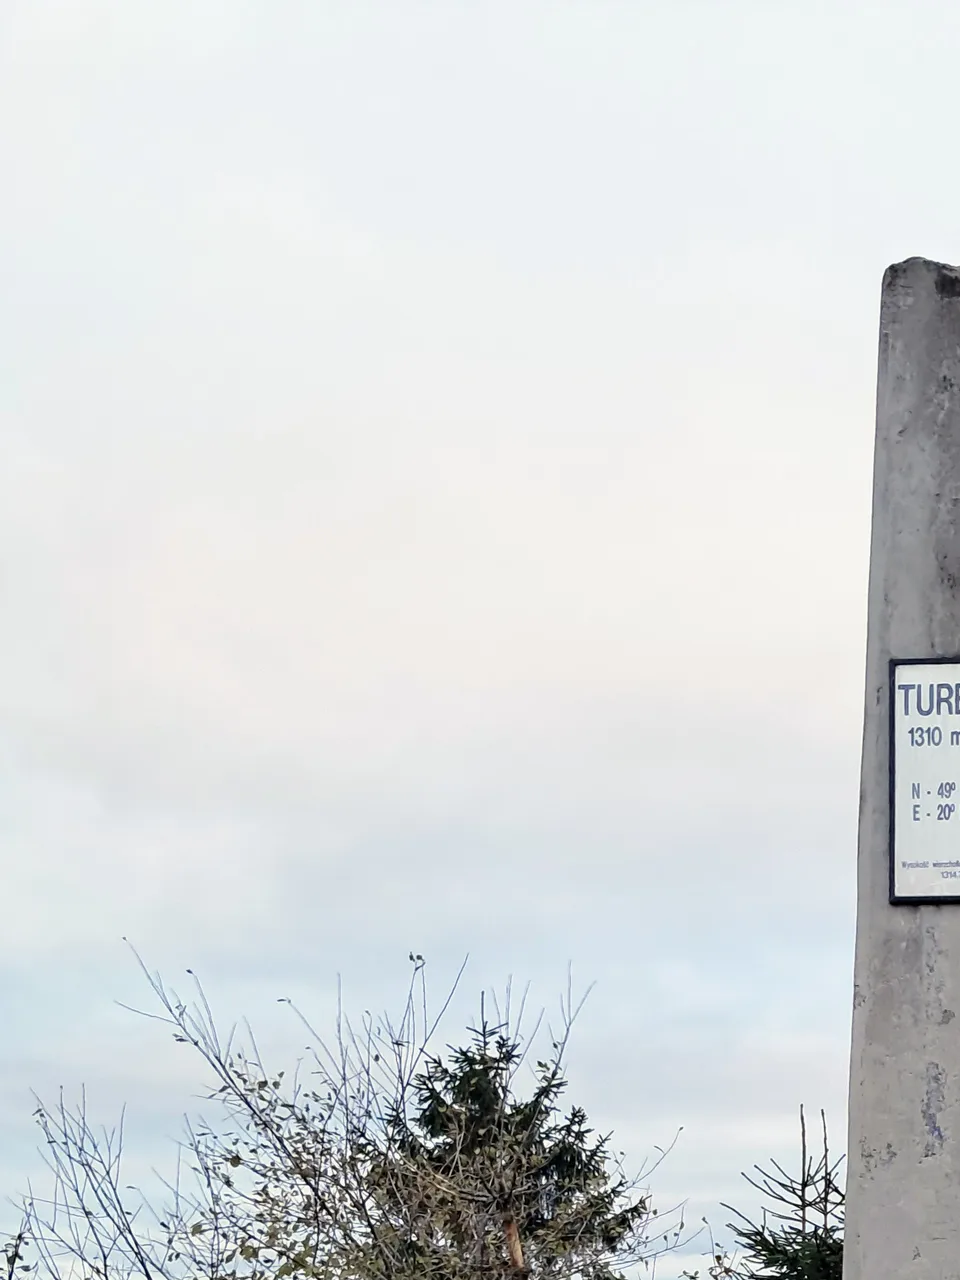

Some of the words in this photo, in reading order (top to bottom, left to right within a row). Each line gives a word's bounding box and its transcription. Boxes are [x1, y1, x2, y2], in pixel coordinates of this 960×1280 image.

[908, 726, 943, 747] 1310
[911, 782, 921, 800] N
[912, 804, 921, 821] E
